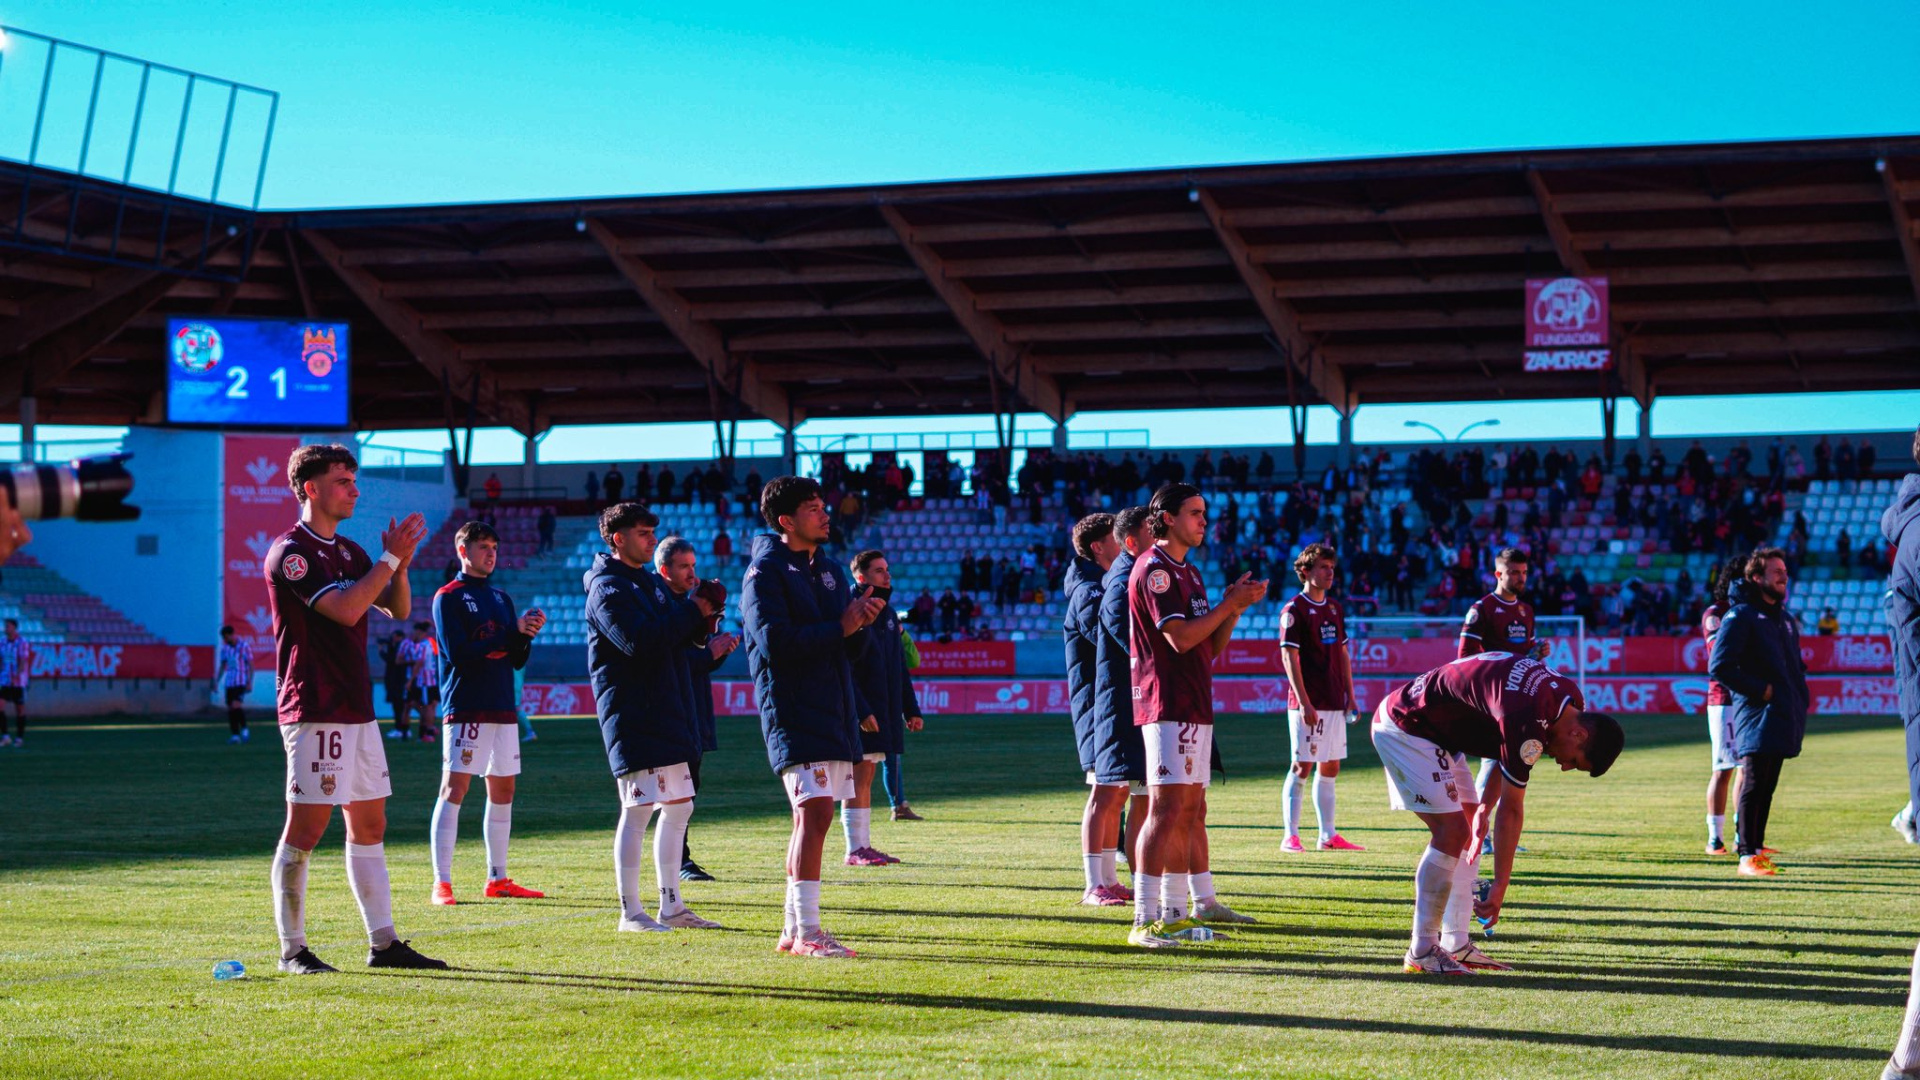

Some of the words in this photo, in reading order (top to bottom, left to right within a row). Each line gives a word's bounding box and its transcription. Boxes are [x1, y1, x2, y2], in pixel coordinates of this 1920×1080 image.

[226, 366, 249, 399] 2
[270, 367, 286, 400] 1
[466, 601, 478, 612] 18
[460, 722, 479, 740] 18
[1178, 722, 1198, 744] 22
[316, 730, 342, 760] 16
[1435, 748, 1449, 770] 8
